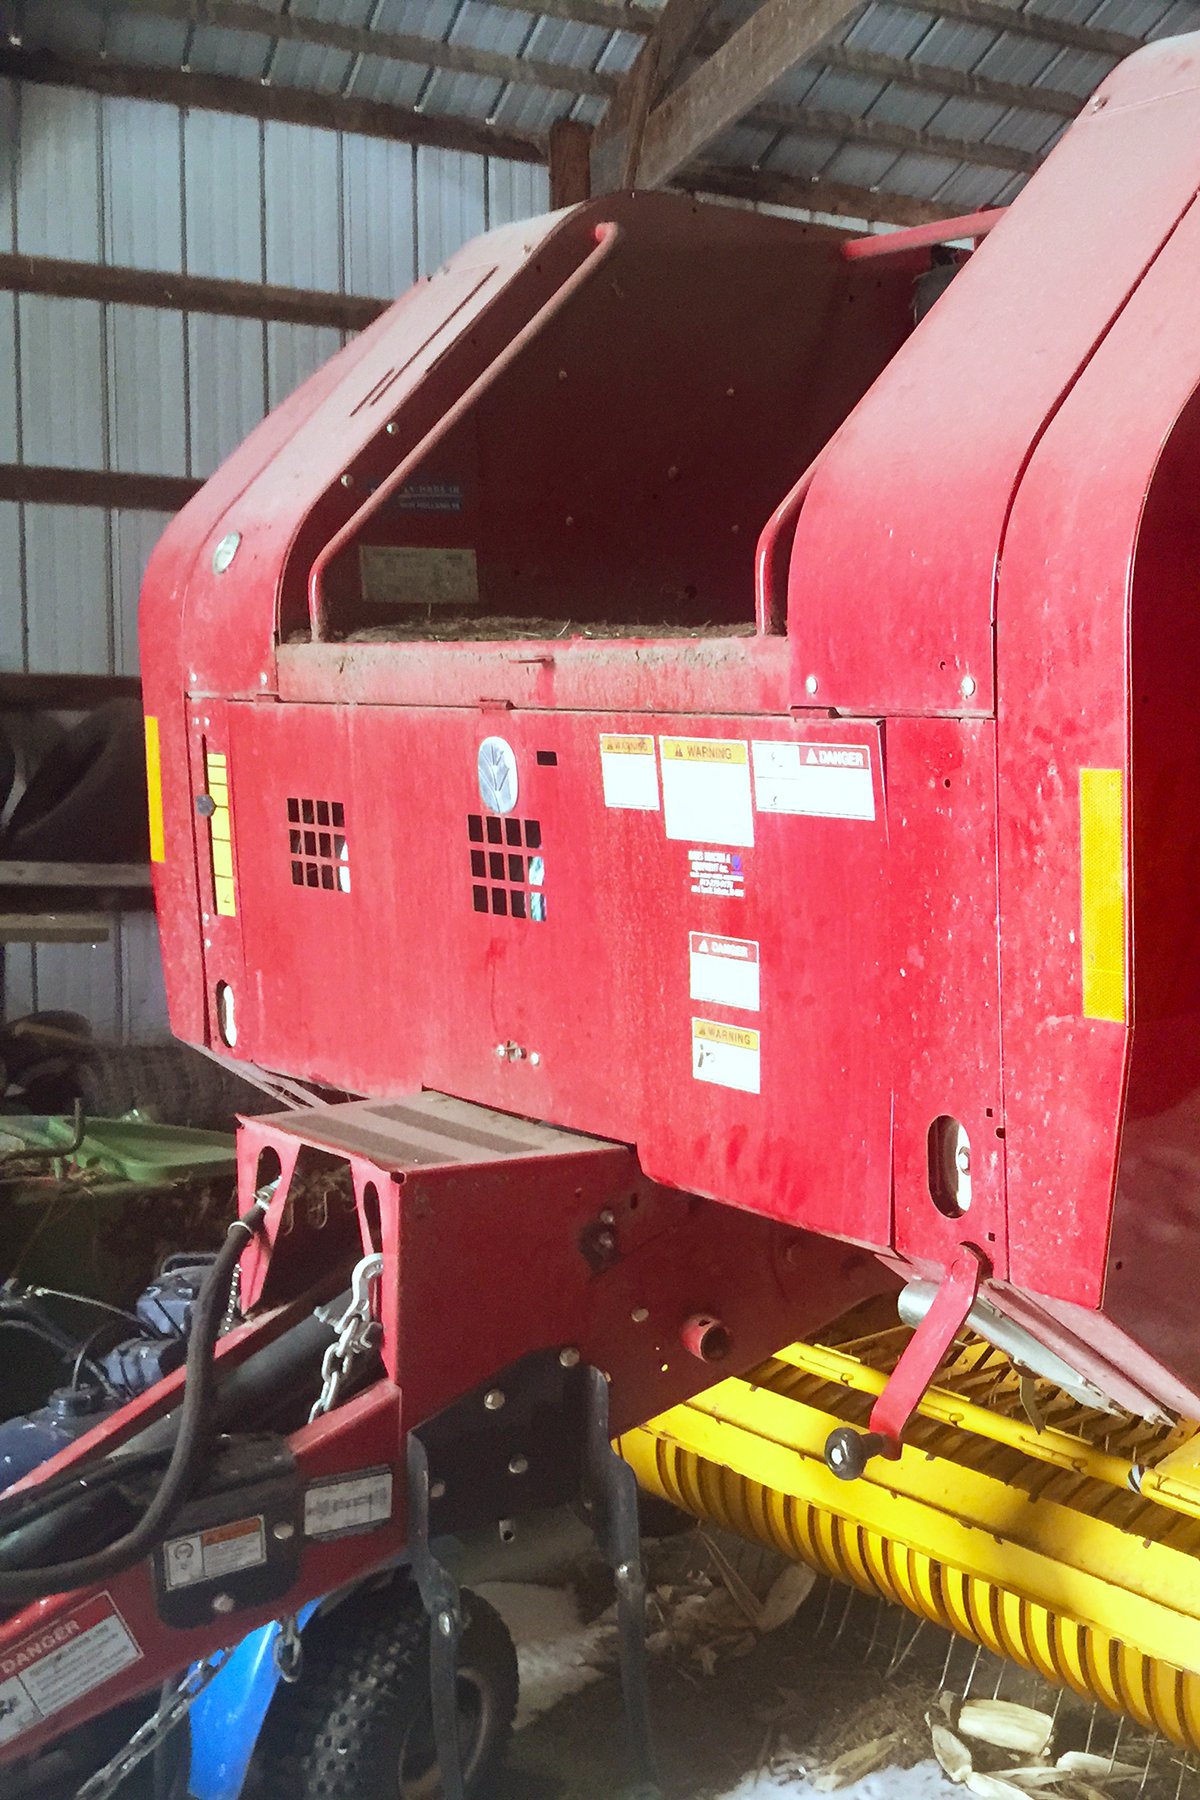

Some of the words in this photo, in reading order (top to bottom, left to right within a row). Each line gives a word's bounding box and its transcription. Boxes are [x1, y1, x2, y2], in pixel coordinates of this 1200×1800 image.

[686, 744, 732, 760] WARNING
[818, 749, 864, 767] DANGER
[708, 1026, 751, 1046] WARNING
[0, 1619, 80, 1674] DANGER
